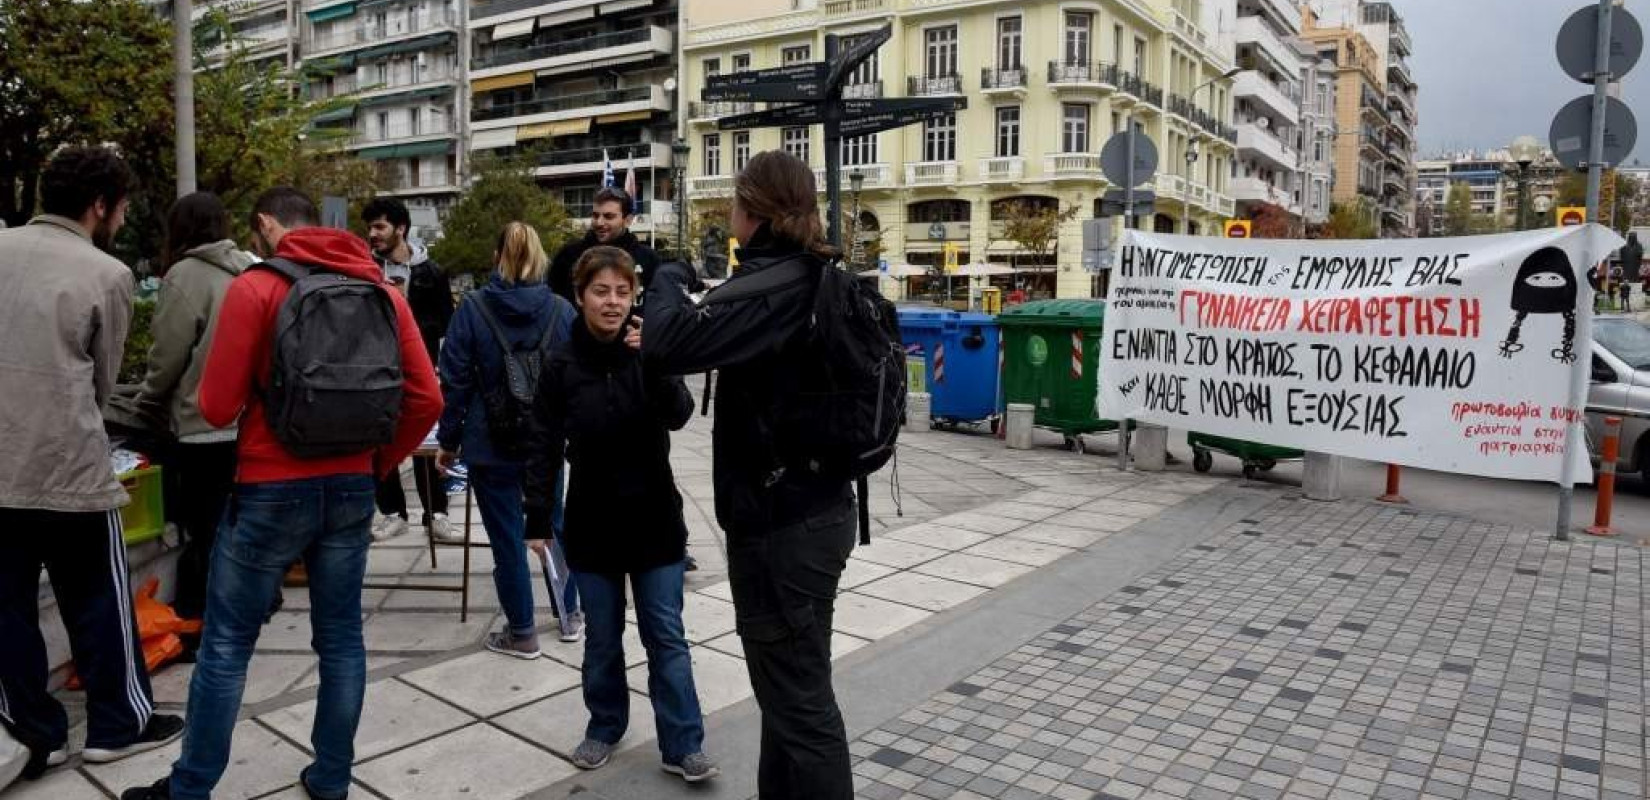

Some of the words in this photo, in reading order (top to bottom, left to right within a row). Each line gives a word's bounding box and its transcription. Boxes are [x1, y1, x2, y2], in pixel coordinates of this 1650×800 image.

[1121, 246, 1135, 277] Η
[1138, 246, 1267, 287] ΑΝΤΙΜΕΤΩΠΙΣΗ
[1291, 255, 1402, 290] ΕΜΦΥΛΗΣ
[1405, 253, 1470, 287] ΒΙΑΣ
[1179, 289, 1291, 332] ΓΥΝΑΙΚΕΙΑ
[1296, 295, 1481, 338] ΧΕΙΡΑΦΕΤΗΣΗ
[1112, 327, 1177, 365] ΕΝΑΝΤΙΑ
[1184, 332, 1218, 366] ΣΤΟ
[1225, 337, 1303, 380] ΚΡΑΤΟΣ,
[1310, 343, 1343, 383] ΤΟ
[1354, 344, 1476, 390] ΚΕΦΑΛΑΙΟ
[1143, 372, 1189, 416] ΚΑΘΕ
[1200, 377, 1273, 425] ΜΟΡΦΗ
[1287, 388, 1407, 438] ΕΞΟΥΣΙΑΣ
